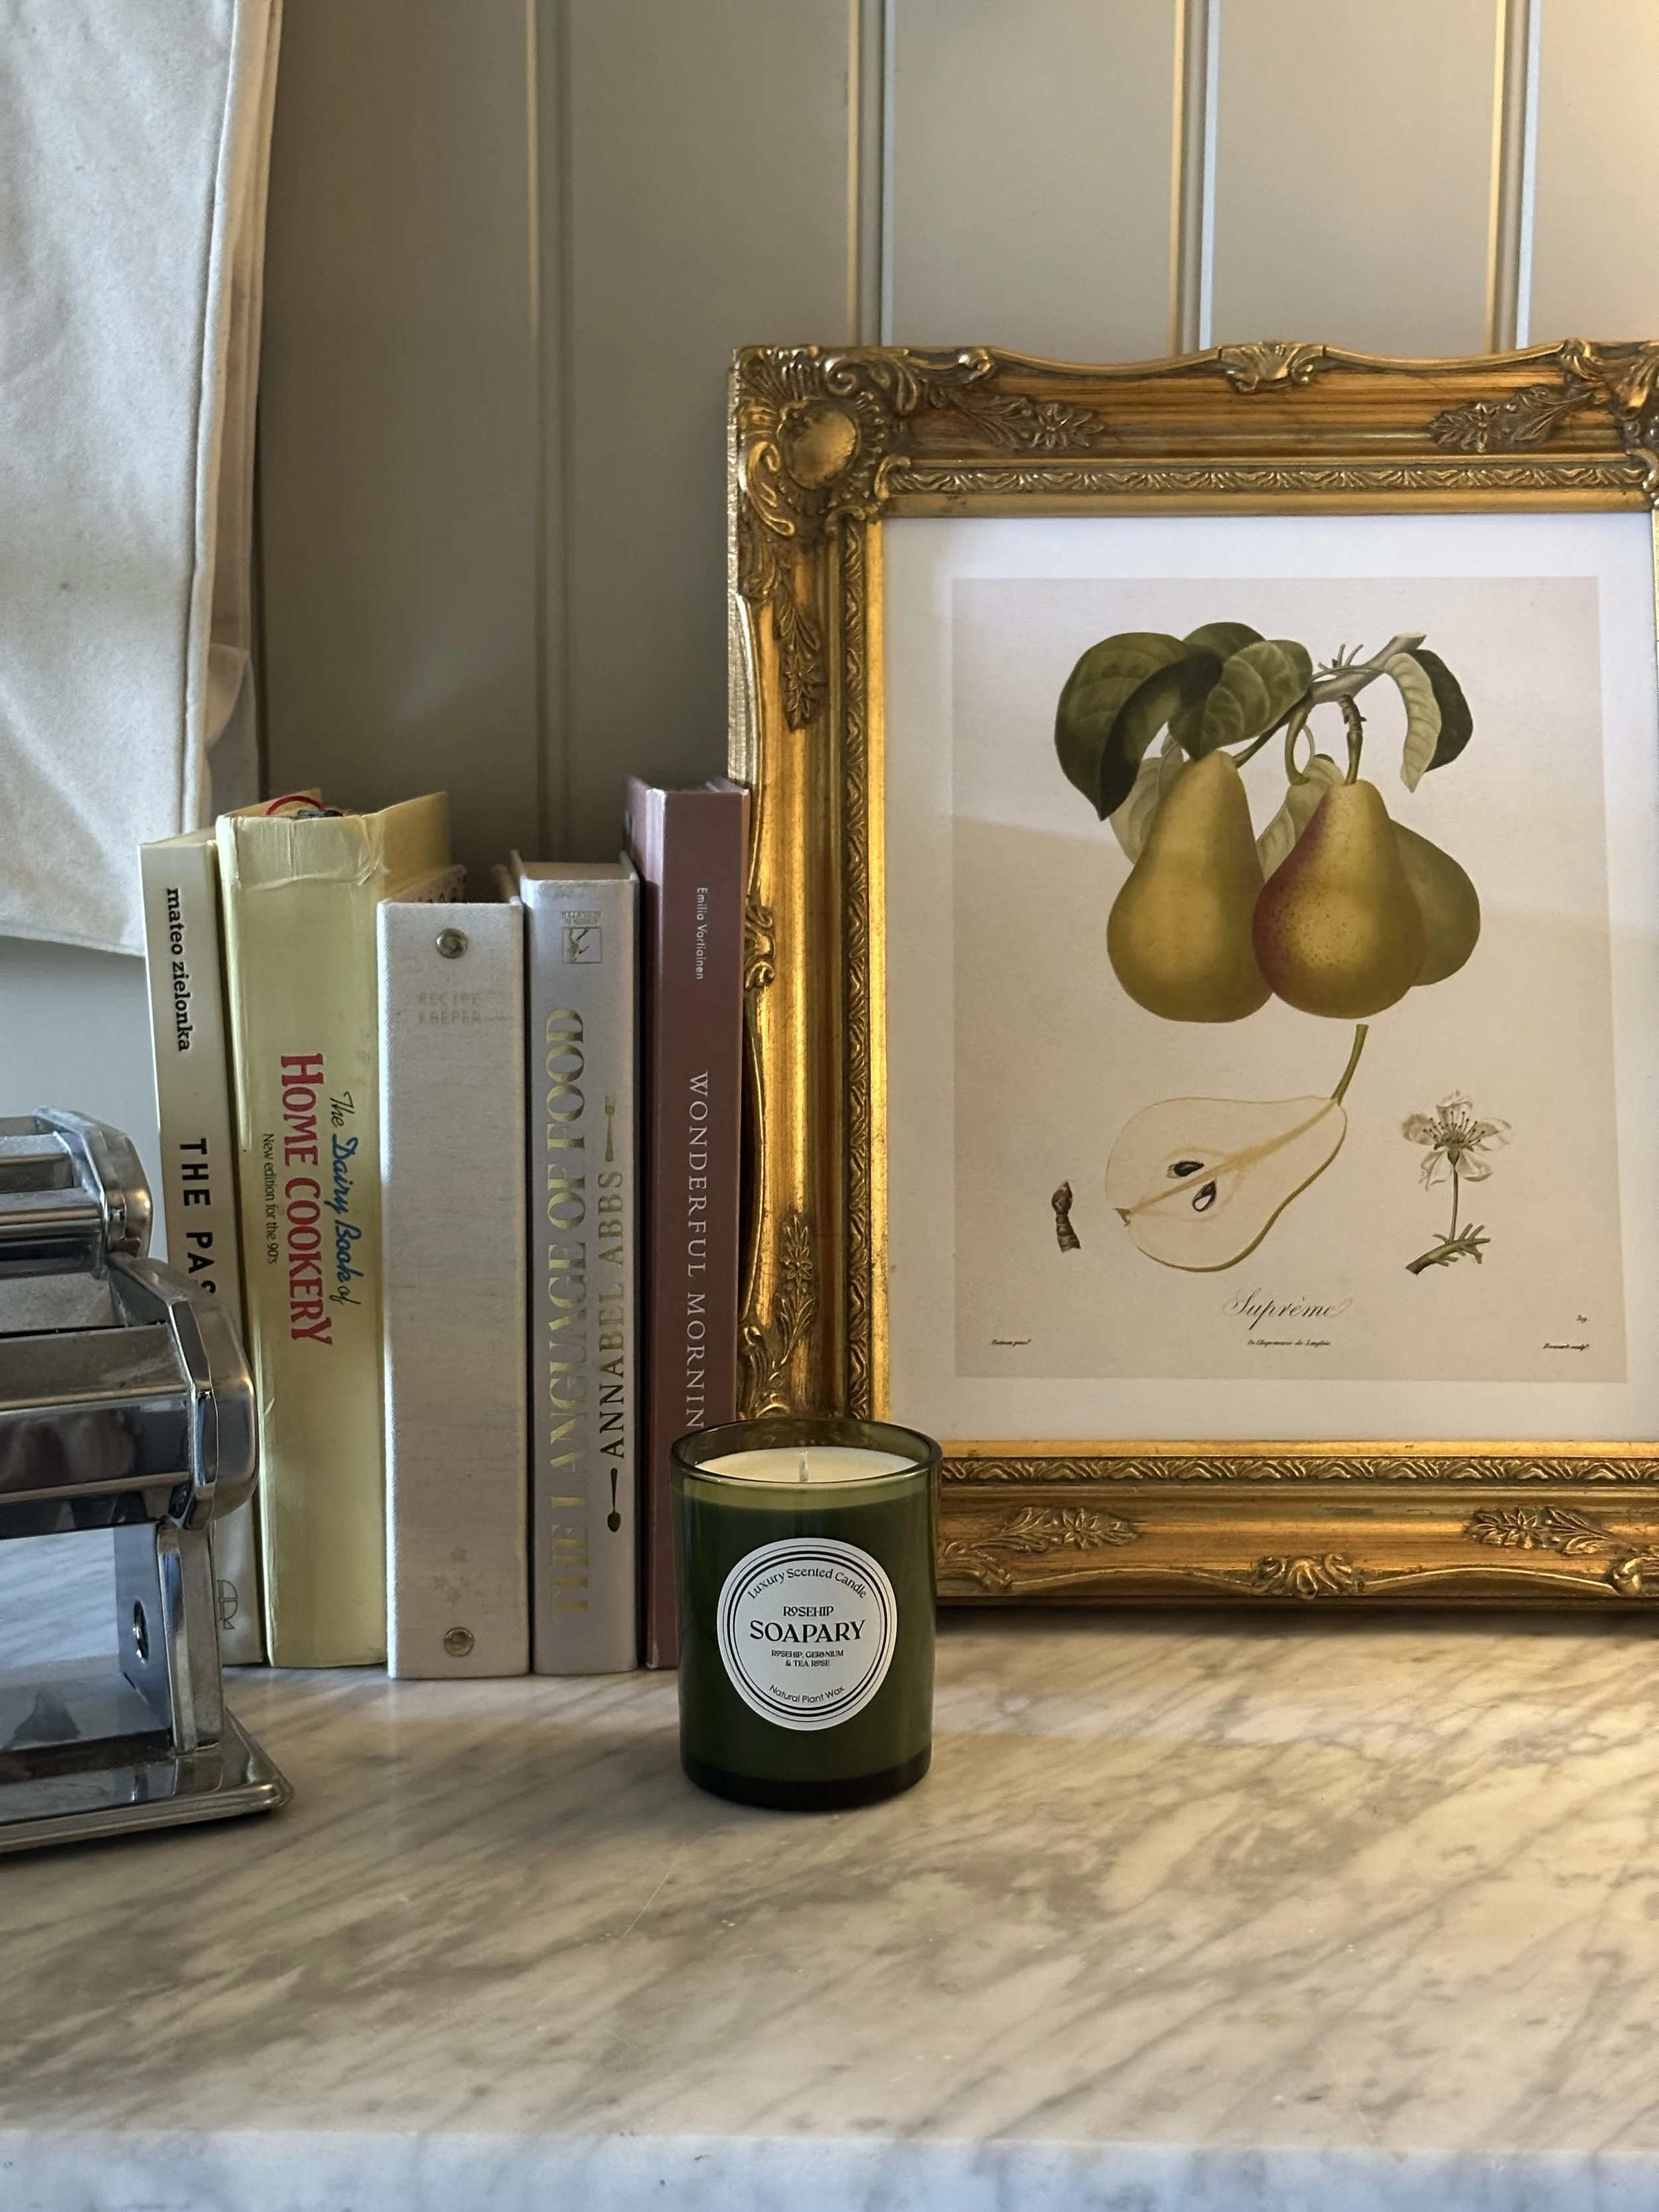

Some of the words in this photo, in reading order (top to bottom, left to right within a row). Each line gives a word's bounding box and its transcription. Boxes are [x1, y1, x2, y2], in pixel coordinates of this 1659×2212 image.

[167, 887, 184, 956] mateo
[696, 887, 708, 921] Emilia
[695, 924, 707, 980] Vartiainen
[172, 961, 193, 1052] zielonka
[281, 1053, 325, 1167] HOME
[330, 1091, 355, 1128] The
[545, 1007, 585, 1151] FOOD
[180, 1138, 211, 1206] THE
[263, 1133, 275, 1160] New
[324, 1133, 360, 1215] Dairy
[687, 1070, 709, 1278] WONDERFUL
[264, 1162, 277, 1201] edition
[266, 1204, 278, 1220] for
[547, 1163, 586, 1229] OF
[267, 1222, 279, 1240] the
[334, 1219, 364, 1283] Book
[597, 1171, 624, 1268] ABBS
[285, 1177, 333, 1346] COOKERY
[329, 1286, 362, 1306] of
[548, 1242, 587, 1509] LANGUAGE
[599, 1283, 624, 1459] ANNABEL
[685, 1291, 706, 1428] MORNIN
[747, 1571, 784, 1599] Luxury
[786, 1568, 834, 1580] Scented
[835, 1572, 867, 1599] Candle
[783, 1605, 834, 1617] ROSEHIP
[749, 1619, 866, 1643] SOAPARY
[805, 1649, 844, 1658] GERANIUM
[768, 1684, 800, 1702] Natural
[802, 1693, 824, 1703] Plant
[824, 1686, 845, 1698] Wax
